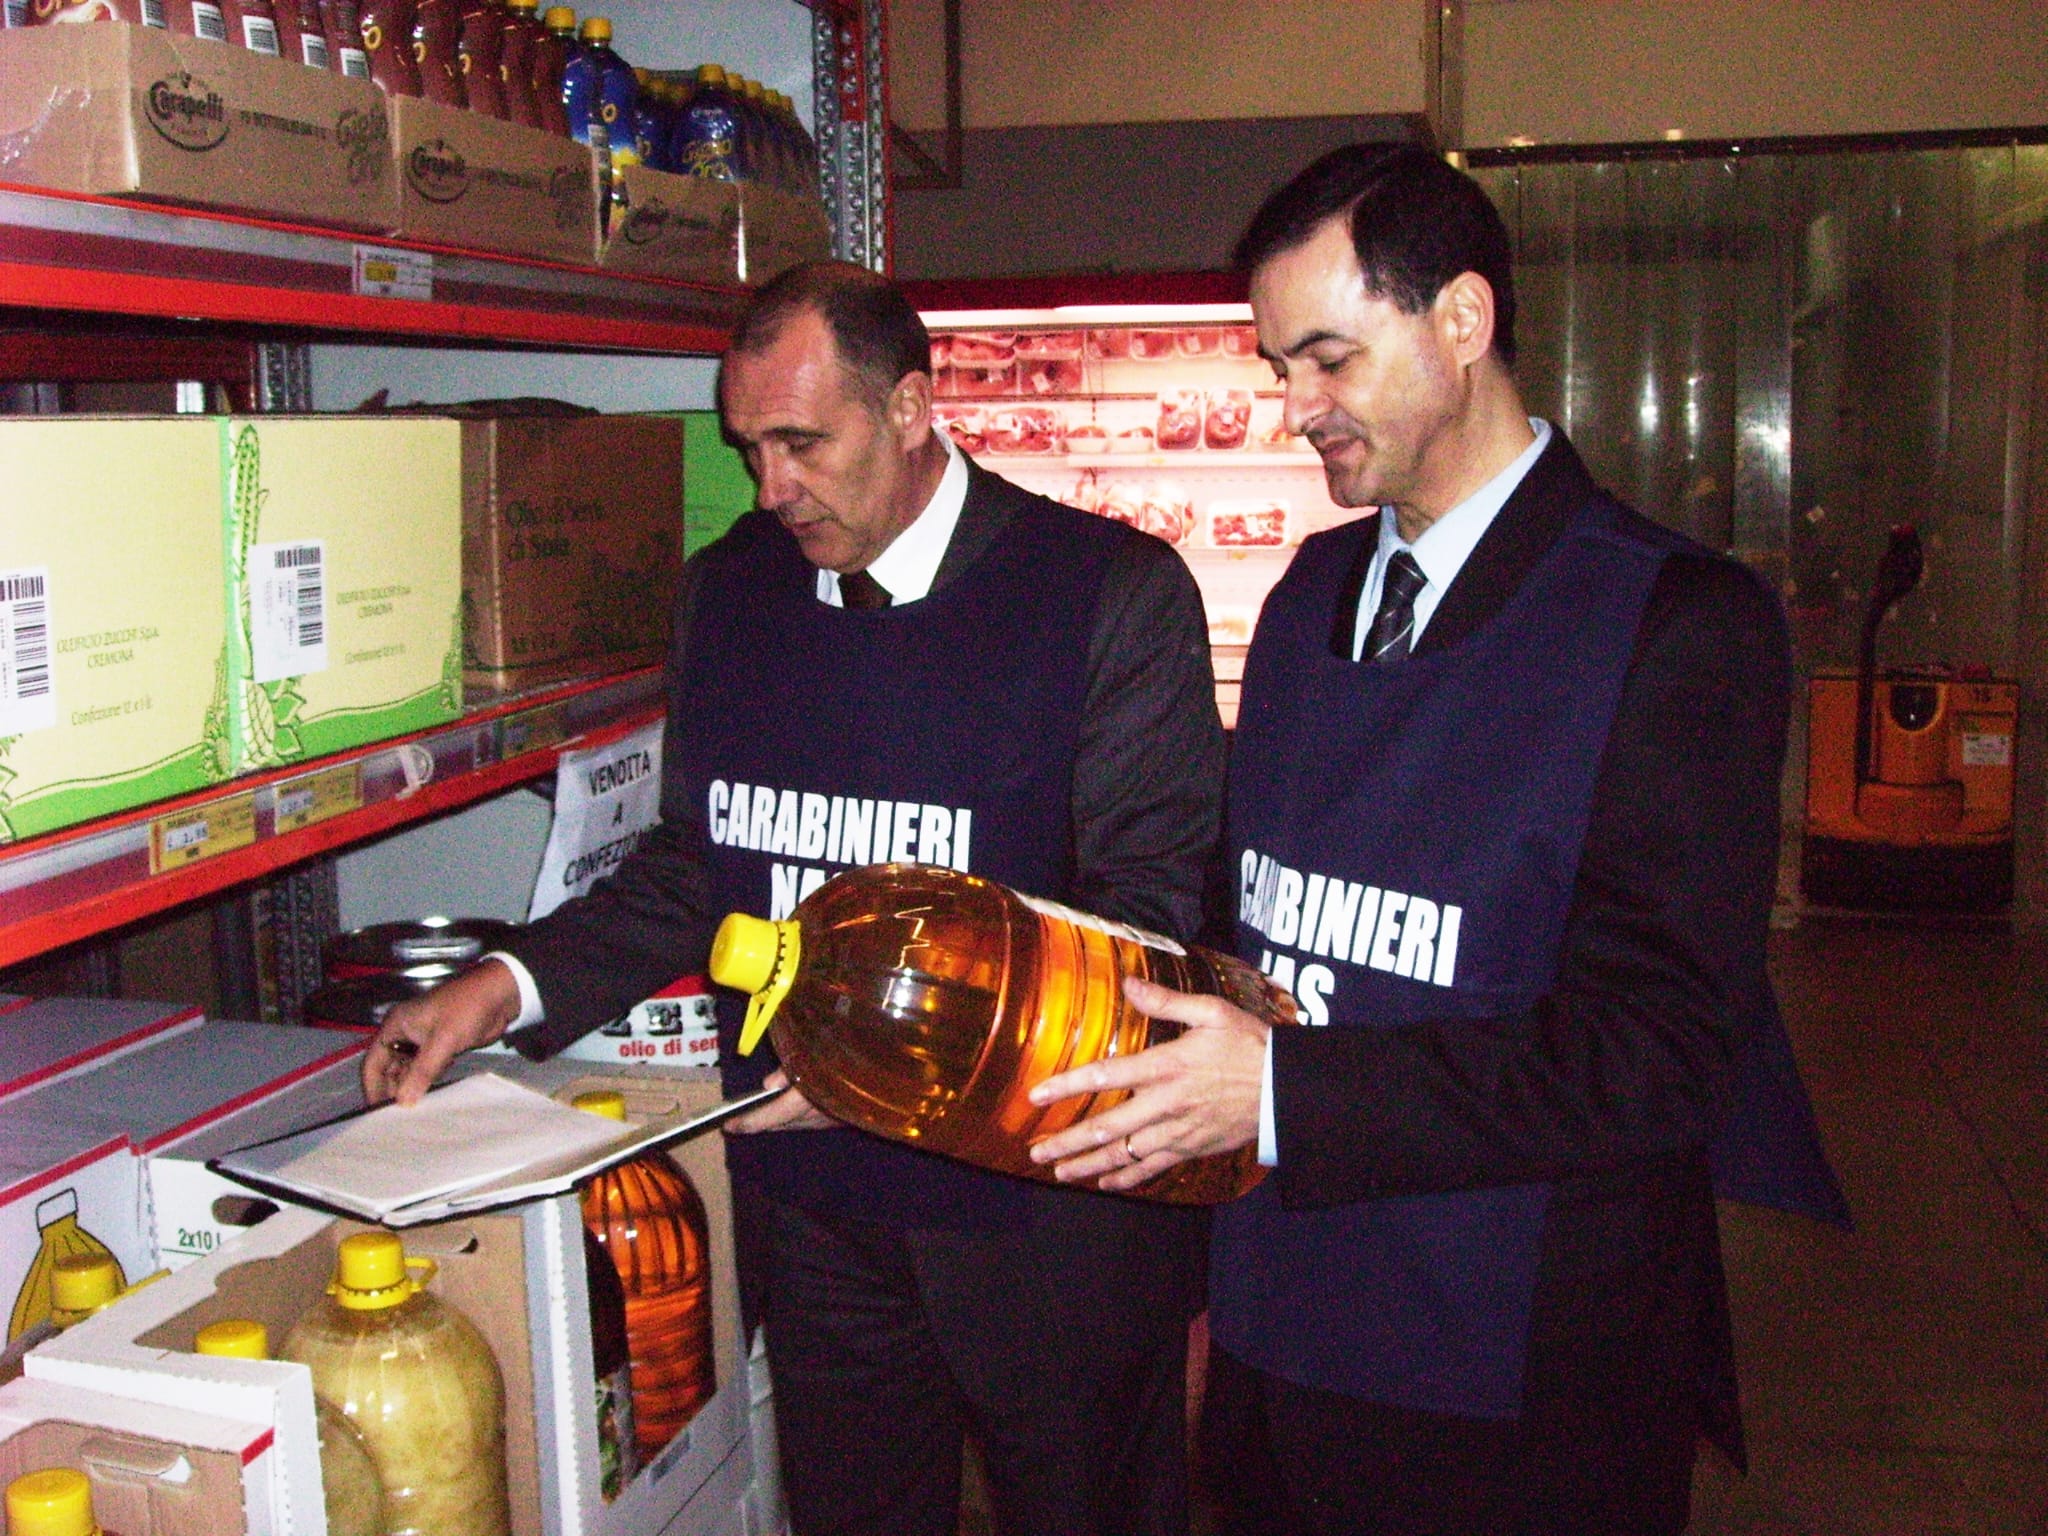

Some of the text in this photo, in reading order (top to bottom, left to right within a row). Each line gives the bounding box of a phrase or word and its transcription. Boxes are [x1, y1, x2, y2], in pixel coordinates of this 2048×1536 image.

[589, 750, 650, 796] VENDITA
[709, 779, 972, 873] CARABINIERI
[619, 1039, 656, 1057] olio
[664, 1039, 681, 1055] di
[178, 1228, 212, 1250] 2x10
